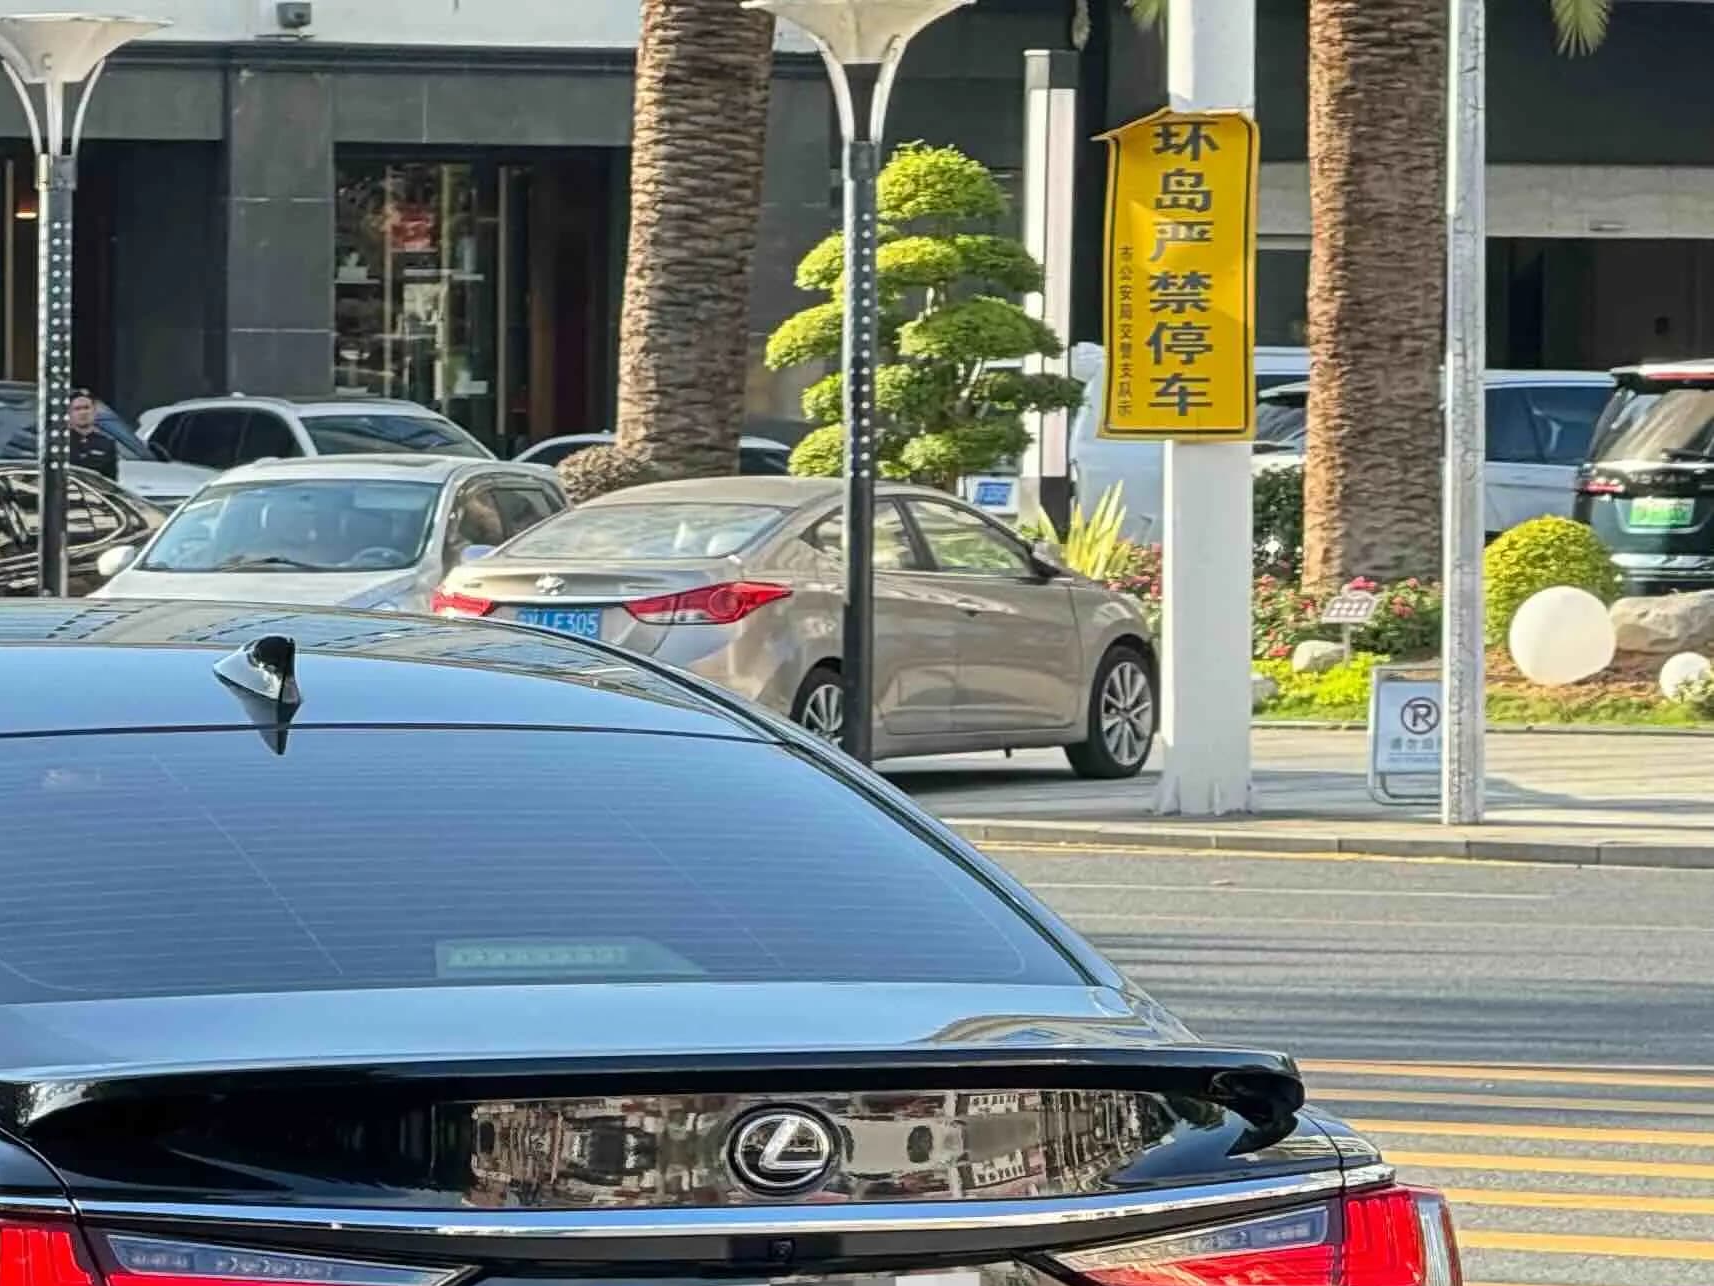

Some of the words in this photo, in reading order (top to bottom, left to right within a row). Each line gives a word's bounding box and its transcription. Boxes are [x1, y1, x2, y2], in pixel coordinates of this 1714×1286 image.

[1146, 122, 1219, 416] 环岛严禁停车
